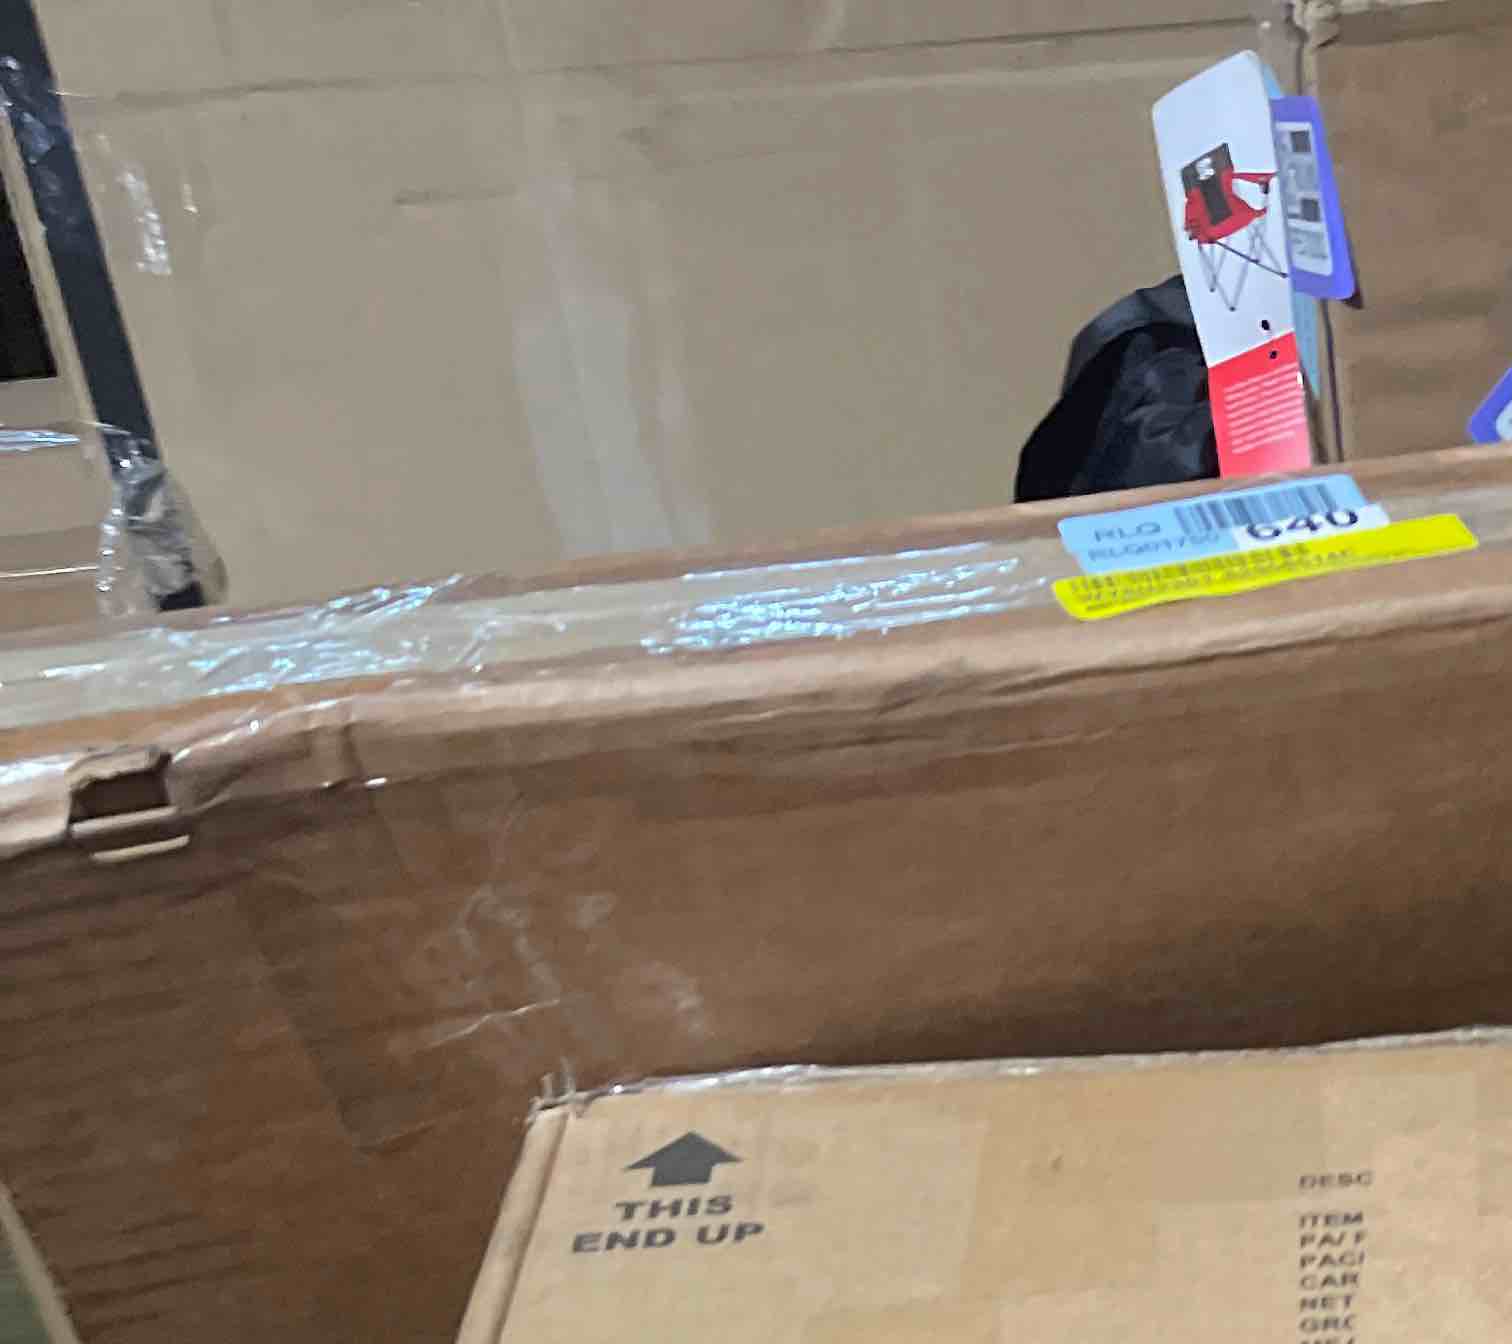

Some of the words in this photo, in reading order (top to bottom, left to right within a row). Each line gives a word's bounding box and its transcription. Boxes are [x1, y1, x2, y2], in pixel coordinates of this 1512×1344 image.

[1246, 507, 1358, 540] 640
[614, 1195, 734, 1221] THIS
[1299, 1211, 1364, 1228] ITEM
[572, 1228, 676, 1254] END
[697, 1222, 765, 1246] UP
